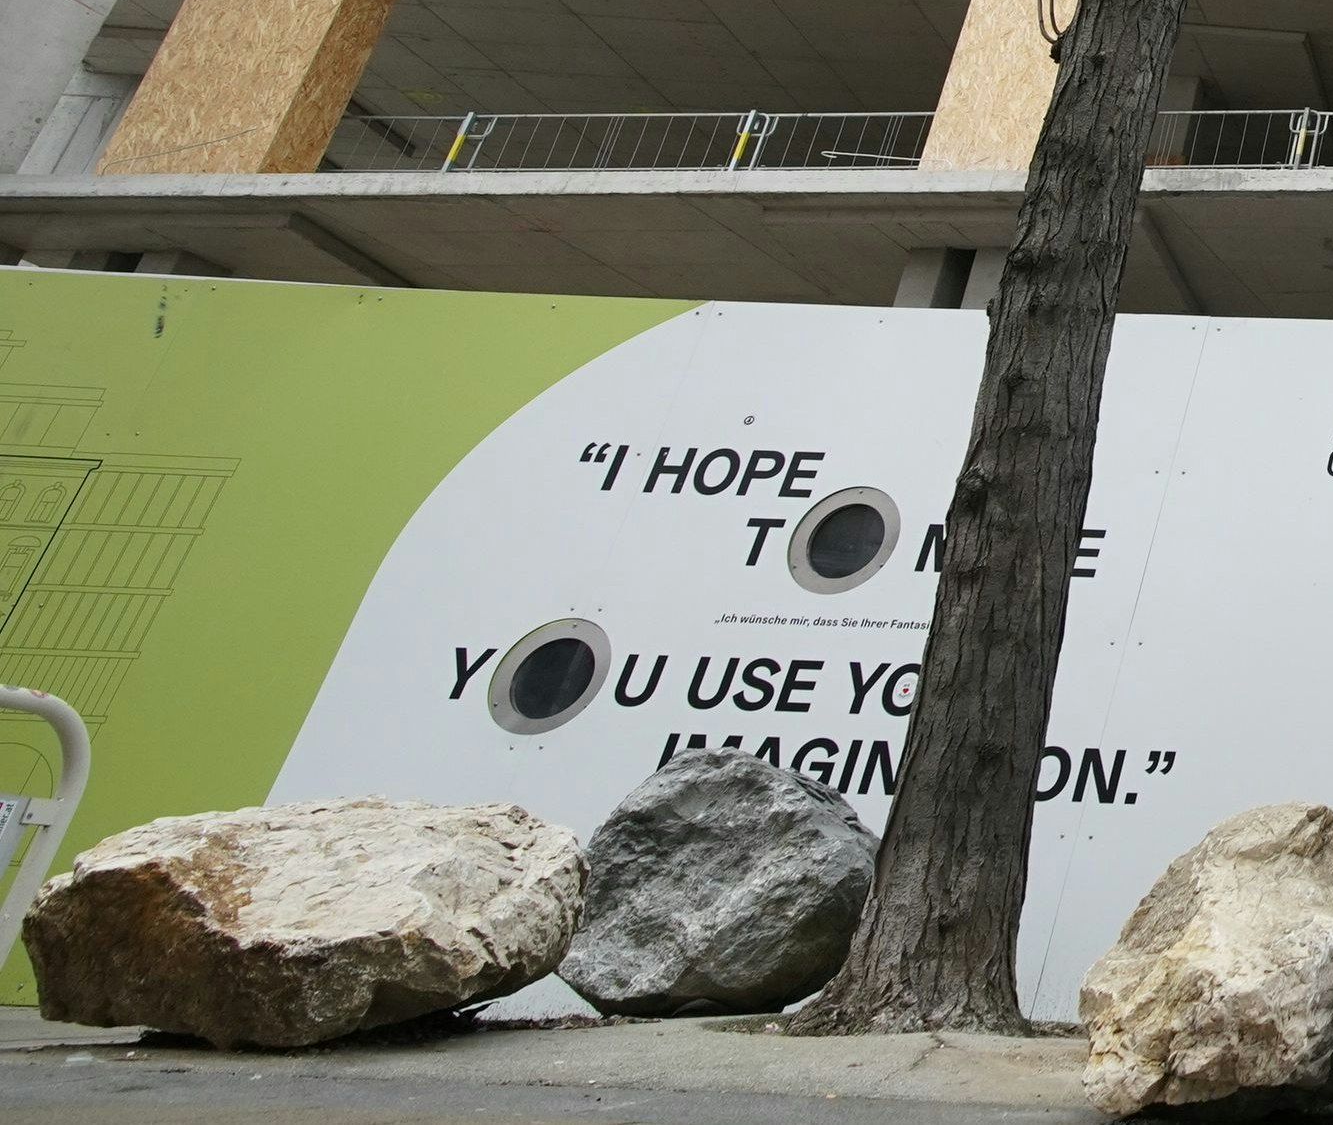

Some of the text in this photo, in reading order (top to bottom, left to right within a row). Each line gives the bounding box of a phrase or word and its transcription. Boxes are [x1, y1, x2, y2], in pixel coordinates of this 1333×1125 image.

[643, 448, 826, 498] HOPE
[740, 614, 788, 626] wünsche
[790, 616, 811, 628] mir,
[813, 616, 839, 628] dass
[841, 618, 858, 628] Sie
[860, 618, 889, 629] Ihrer
[890, 619, 930, 631] Fantasi
[688, 656, 825, 712] USE
